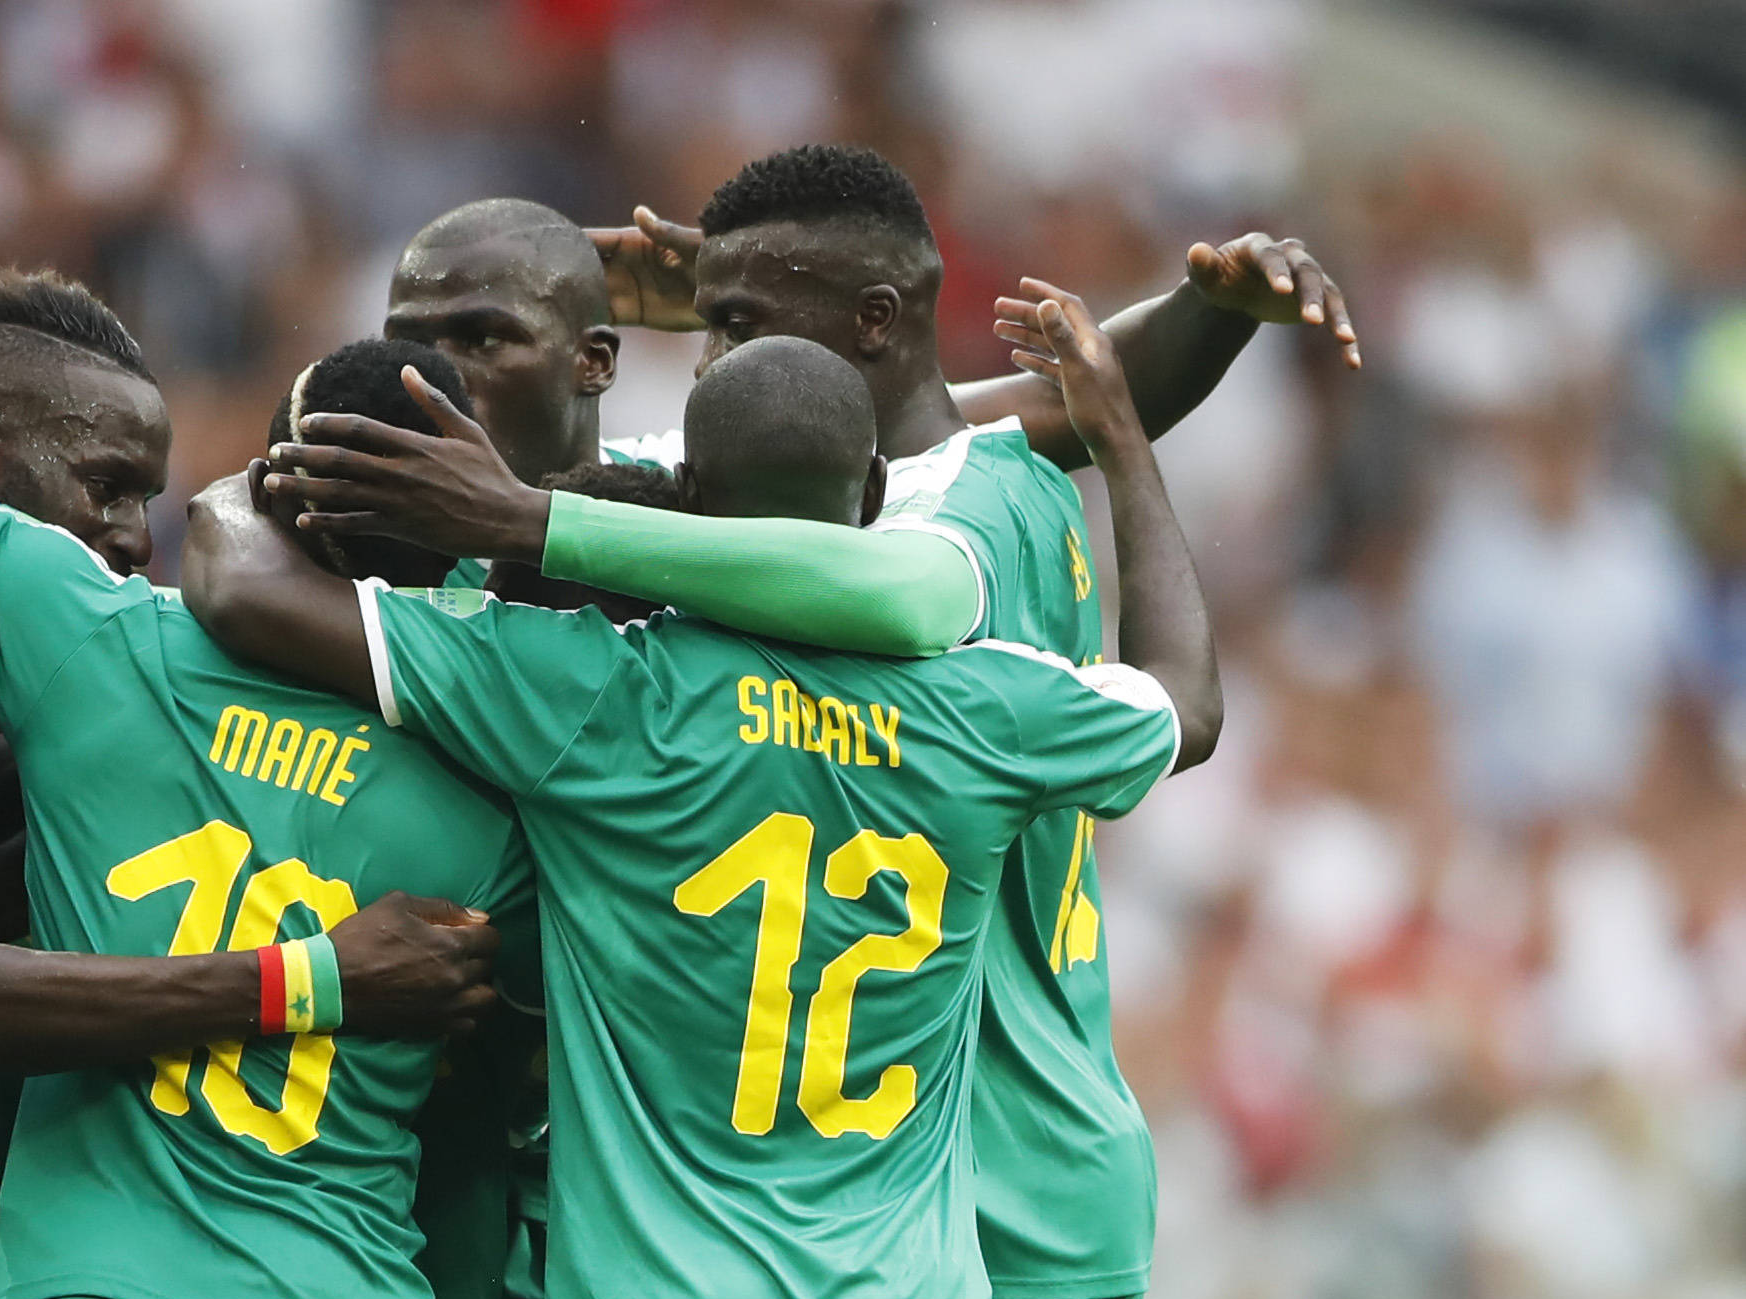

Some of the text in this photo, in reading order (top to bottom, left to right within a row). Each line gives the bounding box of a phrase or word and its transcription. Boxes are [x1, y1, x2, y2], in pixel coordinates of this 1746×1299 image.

[208, 704, 371, 807] MANÉ
[105, 818, 358, 1157] 10
[672, 811, 951, 1142] 12
